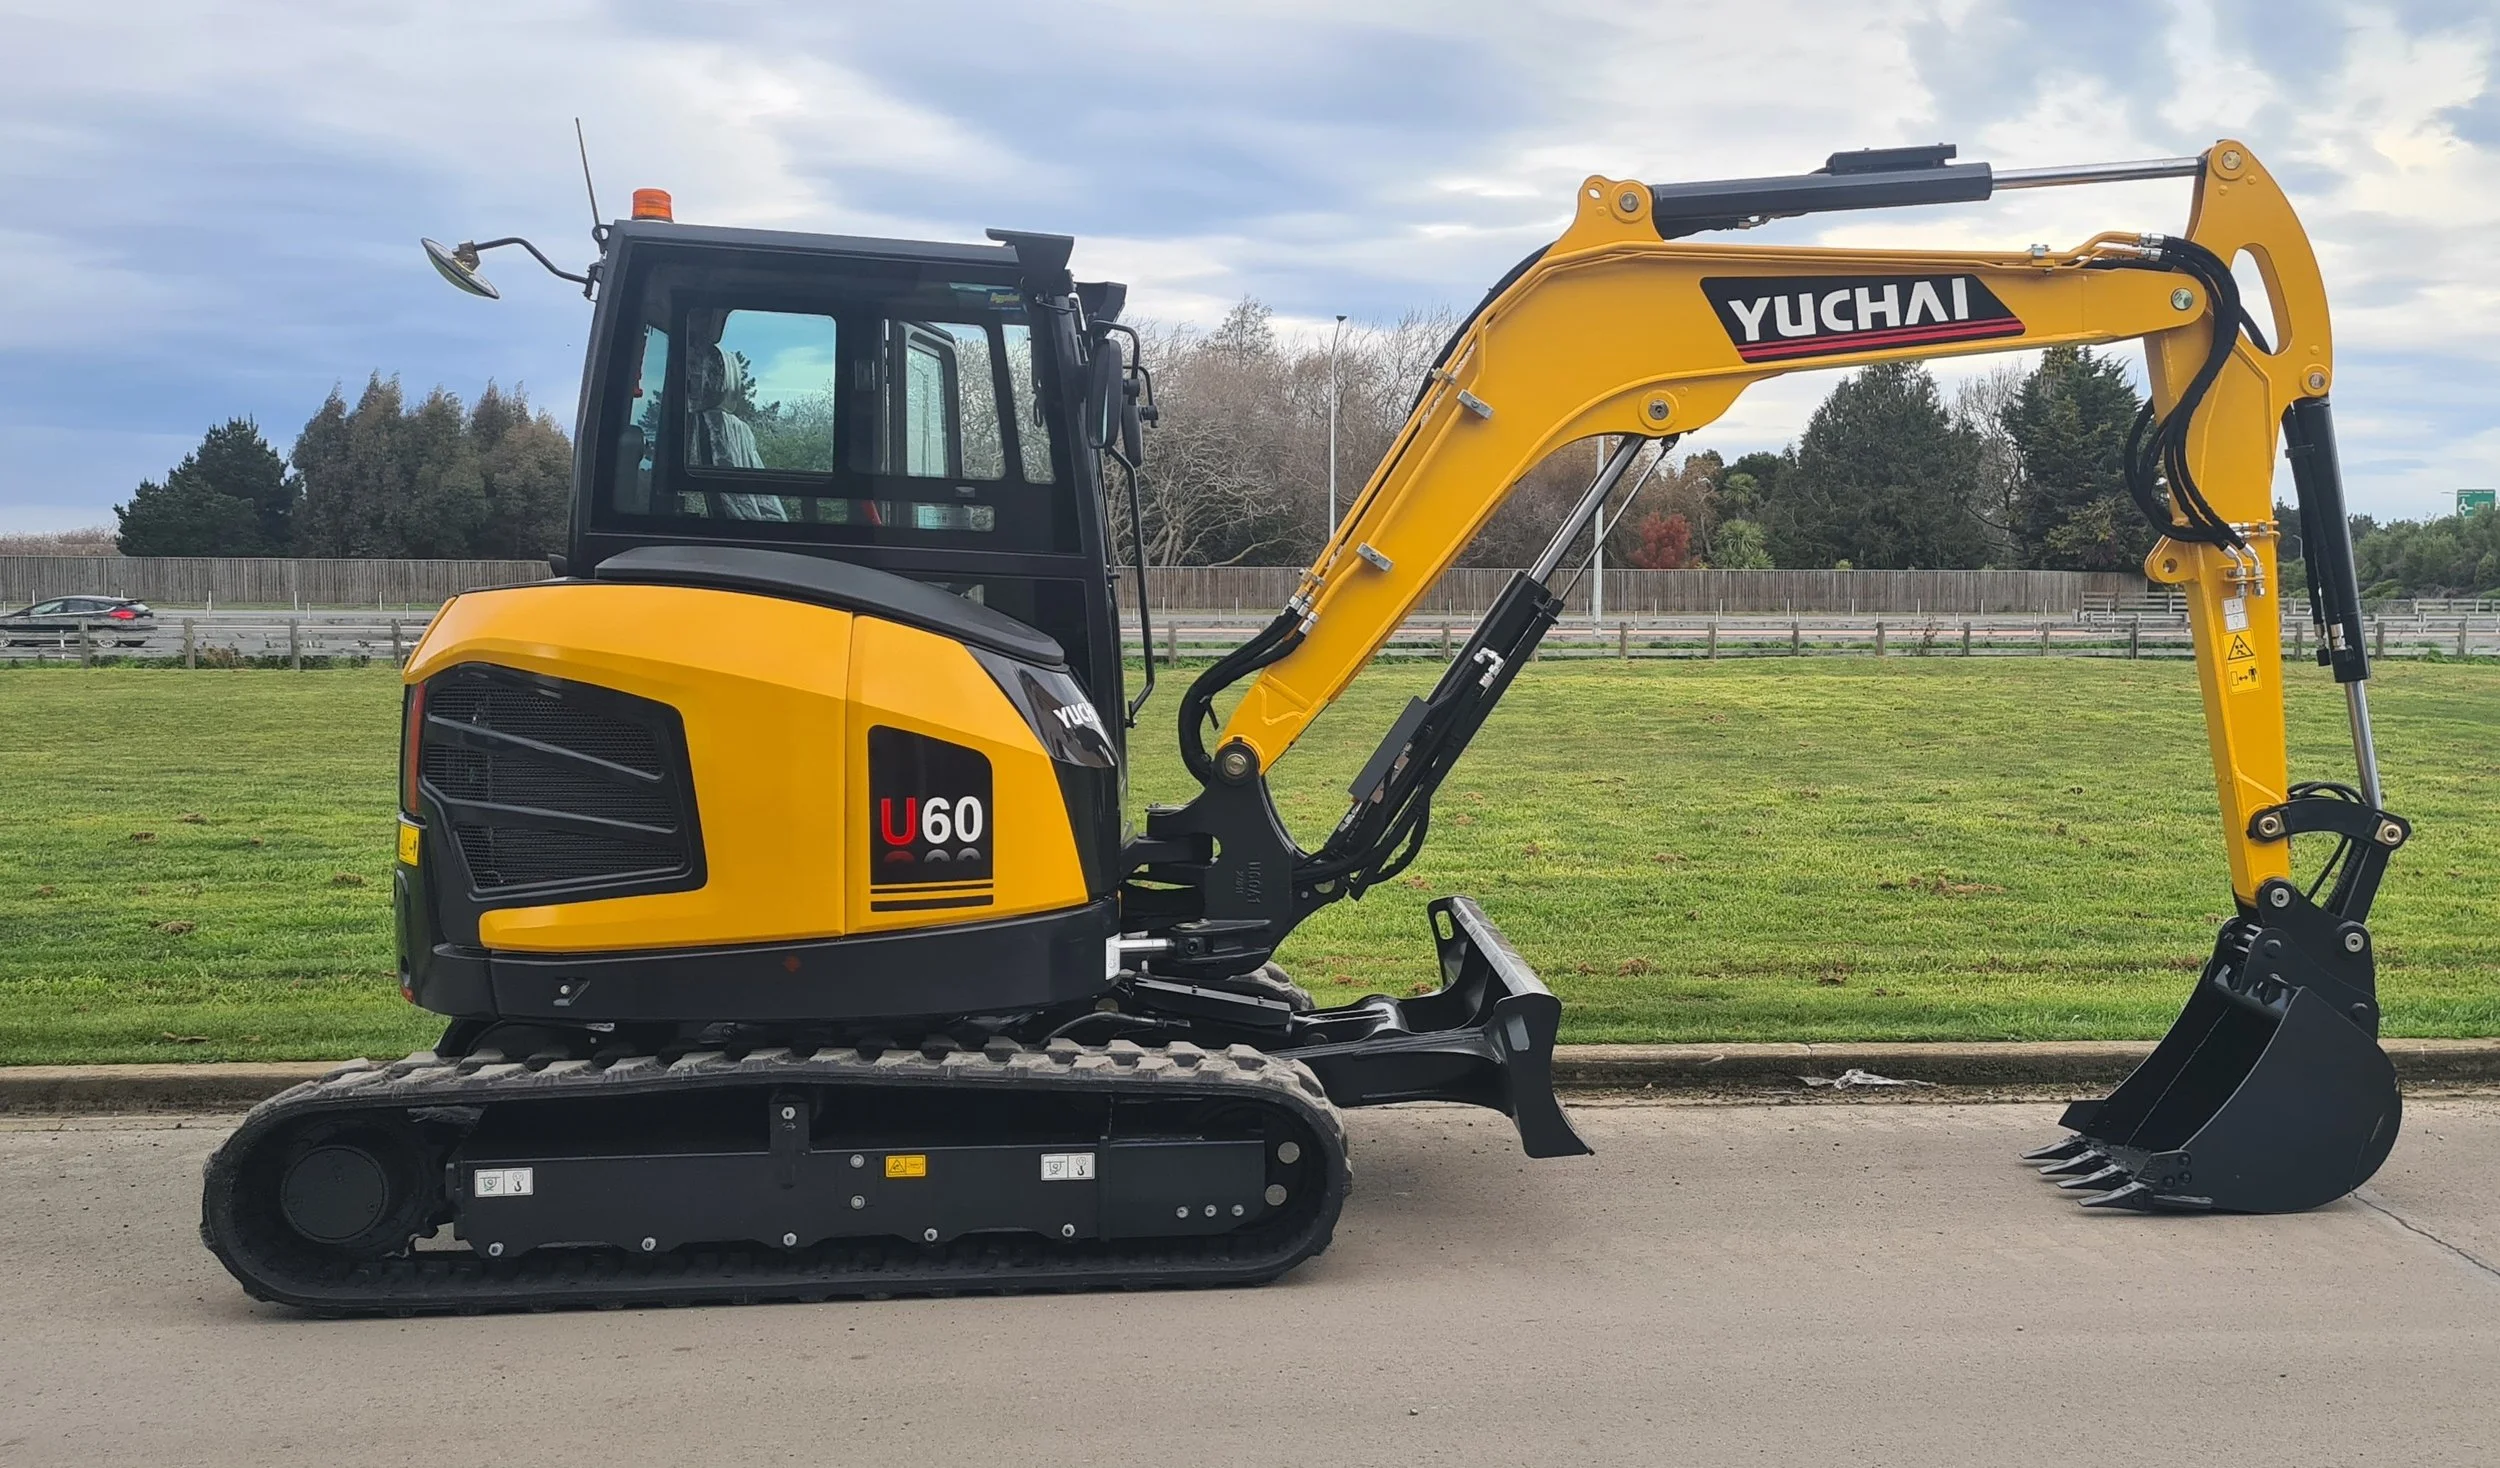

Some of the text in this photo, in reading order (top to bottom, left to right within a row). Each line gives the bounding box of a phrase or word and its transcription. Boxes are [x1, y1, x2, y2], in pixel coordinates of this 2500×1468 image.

[1728, 277, 1969, 341] YUCHAI
[1052, 702, 1099, 729] YUCH
[881, 796, 983, 846] U60
